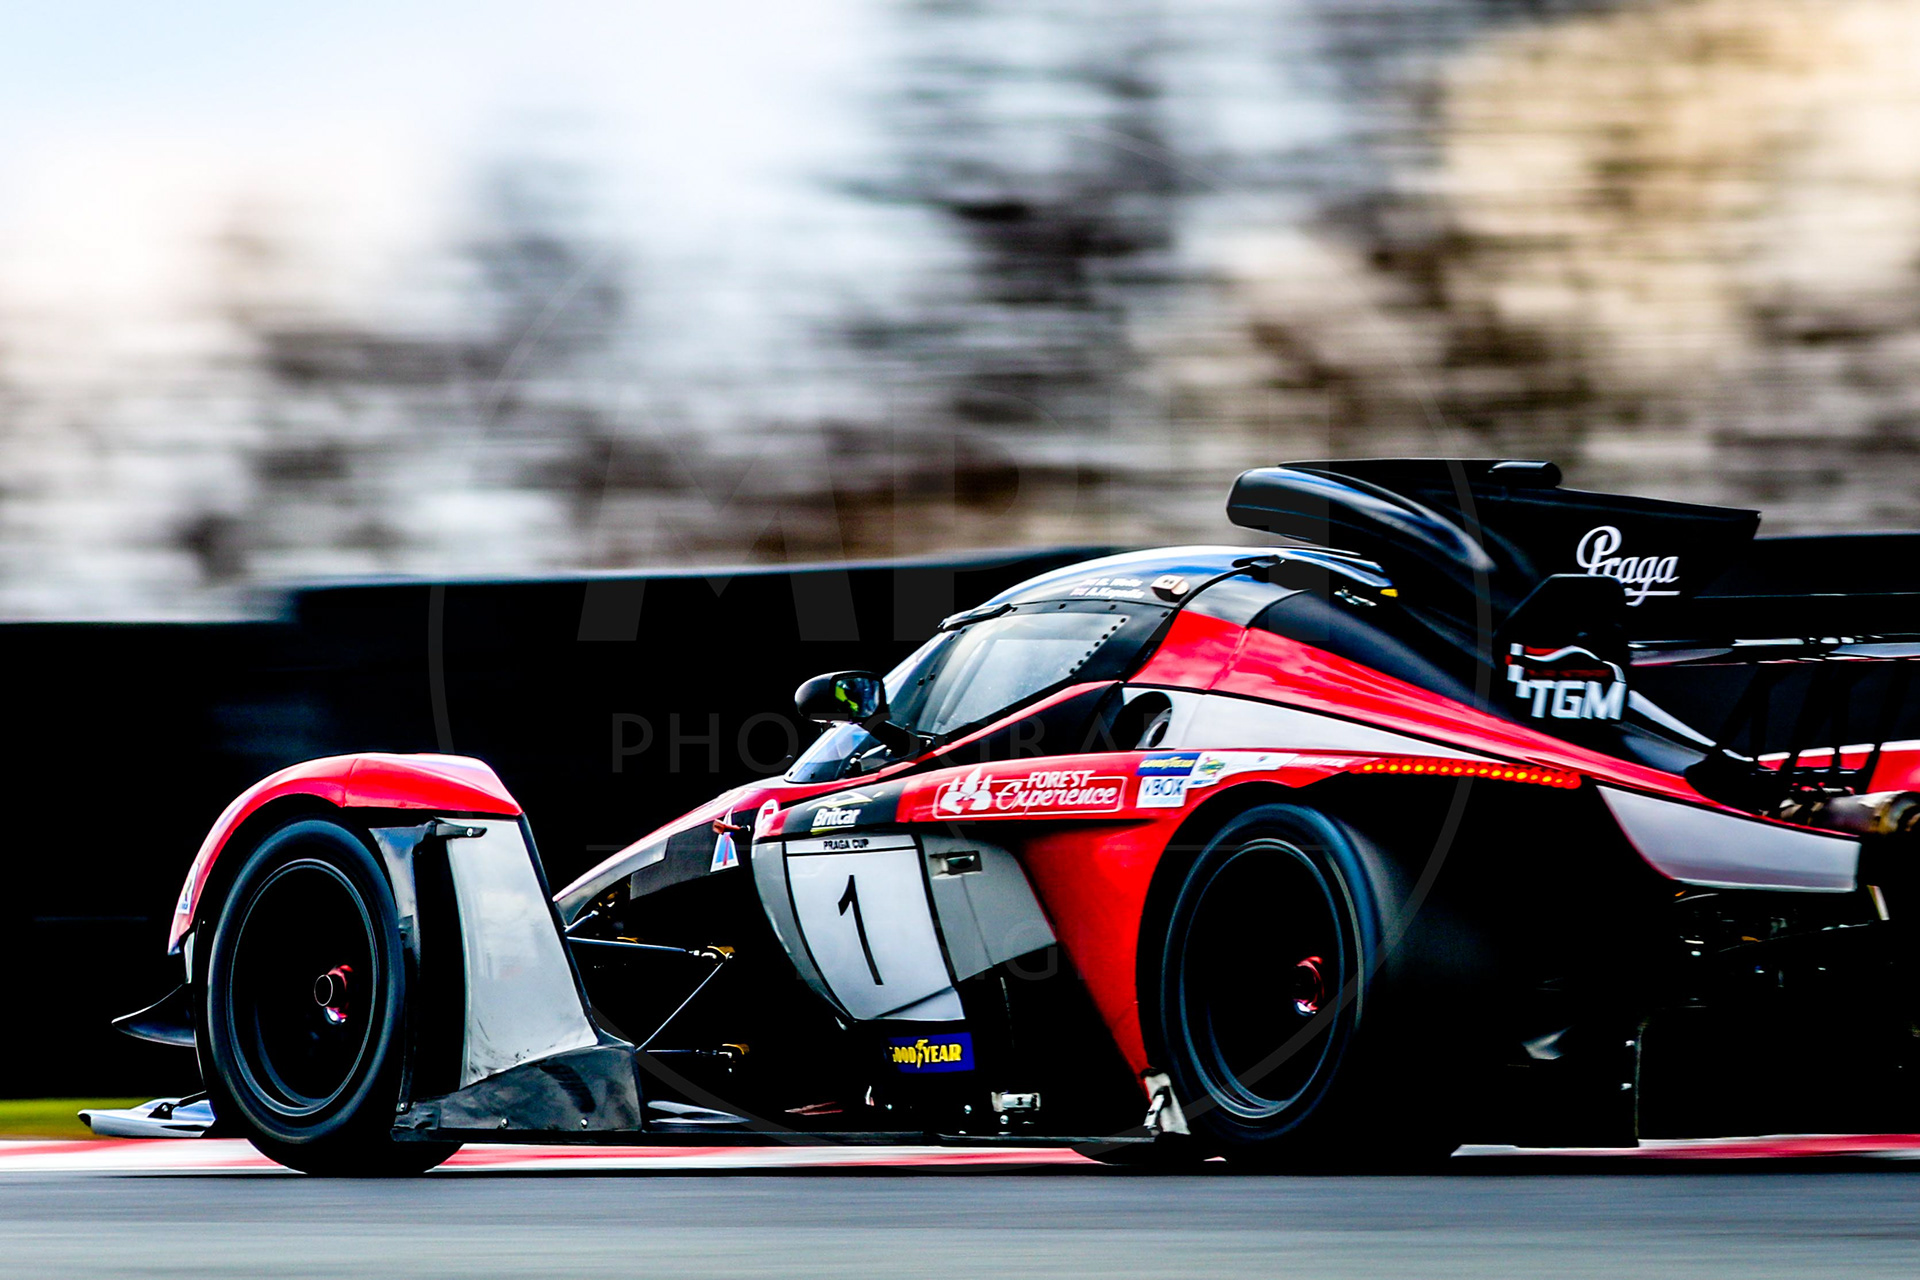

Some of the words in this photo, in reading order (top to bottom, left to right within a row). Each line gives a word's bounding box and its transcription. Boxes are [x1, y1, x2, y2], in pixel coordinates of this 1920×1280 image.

[1576, 525, 1681, 607] Praga
[1527, 678, 1627, 720] TGM
[1026, 769, 1097, 789] FOREST
[811, 807, 862, 828] Britcar
[823, 840, 850, 850] PRAGA
[853, 838, 870, 849] CUP
[838, 874, 884, 986] 1
[889, 1039, 962, 1068] OODYEAR
